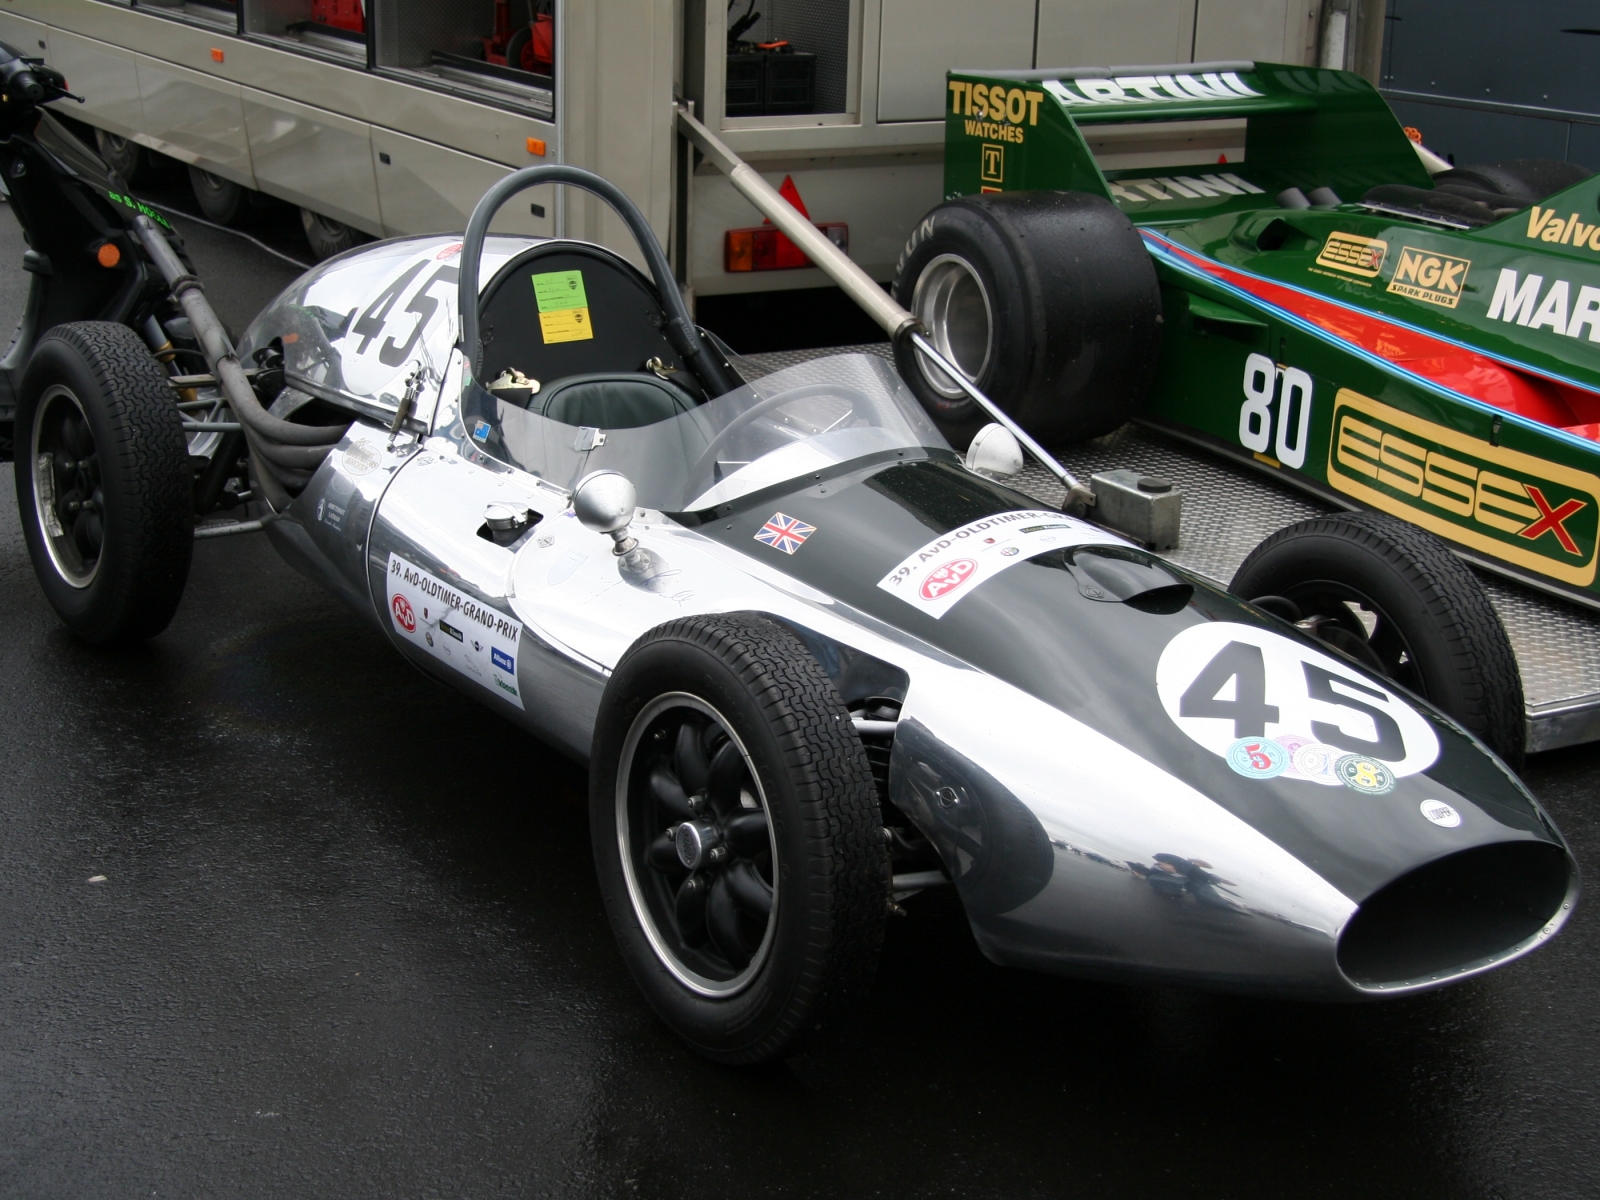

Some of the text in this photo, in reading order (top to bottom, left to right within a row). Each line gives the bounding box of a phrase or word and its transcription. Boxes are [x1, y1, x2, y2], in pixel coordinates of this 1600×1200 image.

[949, 80, 1044, 126] TISSOT
[1042, 72, 1265, 106] ARTINI
[964, 119, 1024, 144] WATCHES
[985, 149, 1001, 175] T
[1107, 173, 1266, 203] RTINI
[1322, 241, 1383, 269] ESSEX
[1396, 250, 1465, 294] NGK
[1390, 284, 1455, 306] SPARK PLUGS
[1485, 267, 1600, 343] MAR
[352, 258, 460, 368] 45
[1238, 352, 1313, 470] 80
[1336, 415, 1588, 557] ESSEX
[888, 565, 918, 587] 39.
[927, 560, 973, 598] AvD
[390, 559, 403, 578] 39.
[403, 567, 519, 643] AvD-OLDTIMER-GRAND-PRIX
[395, 602, 415, 627] AvD
[1178, 639, 1407, 763] 45
[1244, 743, 1272, 771] 5
[1355, 762, 1377, 787] 8
